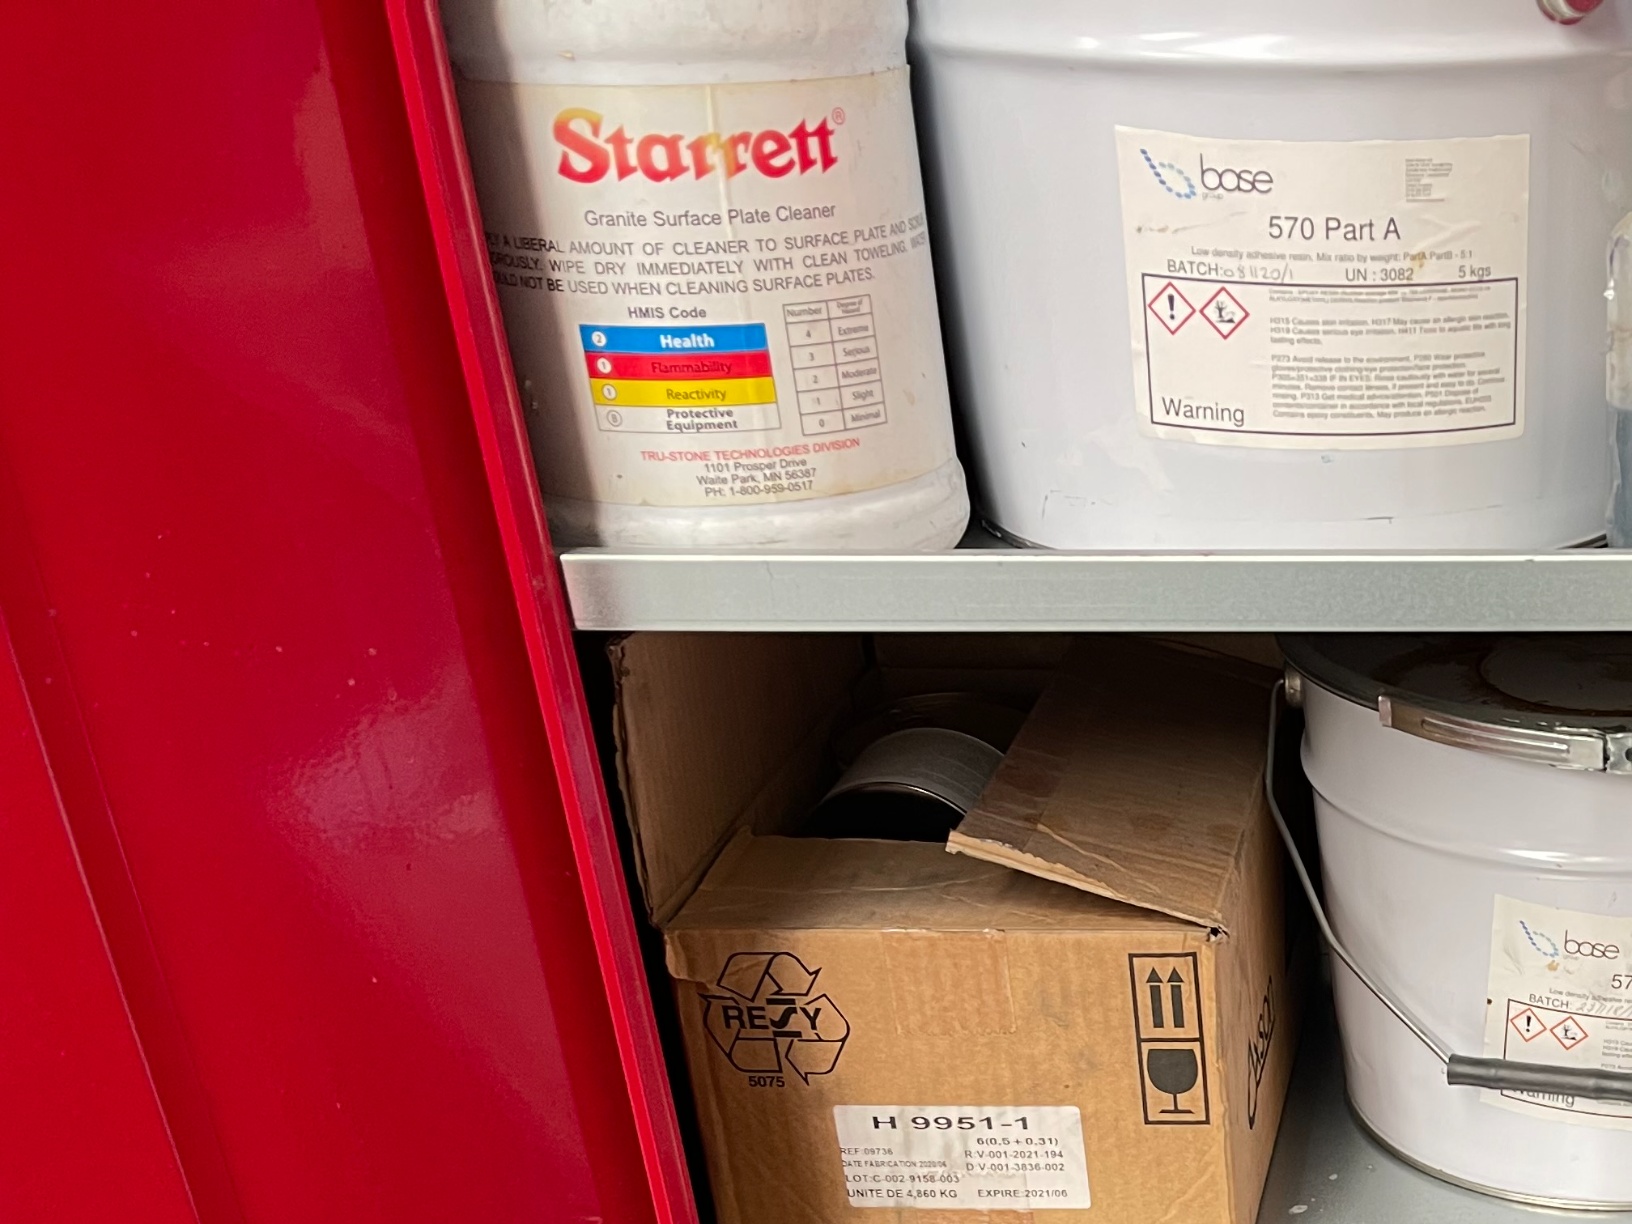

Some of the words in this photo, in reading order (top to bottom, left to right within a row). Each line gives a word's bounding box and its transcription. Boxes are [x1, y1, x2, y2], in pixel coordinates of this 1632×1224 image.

[552, 107, 840, 185] Starrett
[1200, 153, 1274, 195] base
[584, 210, 647, 227] Granite
[653, 211, 722, 227] Surface
[728, 208, 771, 225] Plate
[776, 205, 836, 222] Cleaner
[1268, 216, 1315, 241] 570
[1325, 217, 1374, 241] Part
[1384, 216, 1402, 241] A
[514, 237, 565, 254] LIBERAL
[569, 241, 634, 256] AMOUNT
[642, 242, 665, 256] OF
[672, 240, 749, 256] CLEANER
[755, 238, 777, 253] TO
[784, 231, 849, 251] SURFACE
[854, 225, 887, 243] PLATE
[889, 221, 907, 236] AND
[550, 259, 585, 274] WIPE
[594, 261, 626, 275] DRY
[637, 260, 744, 276] IMMEDIATELY
[753, 256, 793, 272] WITH
[802, 250, 848, 268] CLEAN
[1211, 247, 1244, 261] density
[1316, 252, 1332, 262] Mix
[1356, 252, 1368, 264] by
[1167, 259, 1223, 277] BATCH:
[1345, 267, 1369, 282] UN
[1379, 267, 1415, 282] 3082
[1458, 266, 1467, 278] 5
[1469, 264, 1492, 280] kgs
[519, 275, 544, 291] NOT
[547, 277, 565, 292] BE
[567, 280, 609, 294] USED
[611, 281, 662, 295] WHEN
[666, 279, 749, 296] CLEANING
[752, 274, 823, 292] SURFACE
[627, 306, 665, 319] HMIS
[669, 306, 707, 319] Code
[786, 307, 822, 318] Number
[837, 325, 869, 336] Extreme
[659, 333, 715, 348] Health
[651, 361, 732, 375] Flammability
[841, 367, 877, 380] Moderate
[666, 389, 727, 402] Reactivity
[852, 389, 875, 402] Slight
[667, 408, 734, 420] Protective
[851, 410, 881, 423] Minimal
[1161, 396, 1245, 428] Warning
[666, 419, 739, 433] Equipment
[641, 450, 711, 462] TRU-STONE
[715, 443, 811, 461] TECHNOLOGIES
[812, 437, 860, 454] DIVISION
[705, 462, 730, 474] 1101
[733, 460, 777, 474] Prosper
[779, 458, 808, 469] Drive
[696, 475, 728, 486] Waite
[763, 471, 783, 482] MN
[785, 468, 817, 481] 56387
[729, 480, 814, 497] 1-800-959-0517
[1564, 929, 1620, 960] base
[722, 1004, 822, 1032] RESY
[748, 1075, 785, 1088] 5075
[872, 1116, 897, 1130] H
[910, 1116, 1029, 1130] 9951-1
[842, 1160, 863, 1168] DATE
[847, 1188, 884, 1198] UNITE
[887, 1189, 904, 1198] DE
[940, 1189, 958, 1198] KG
